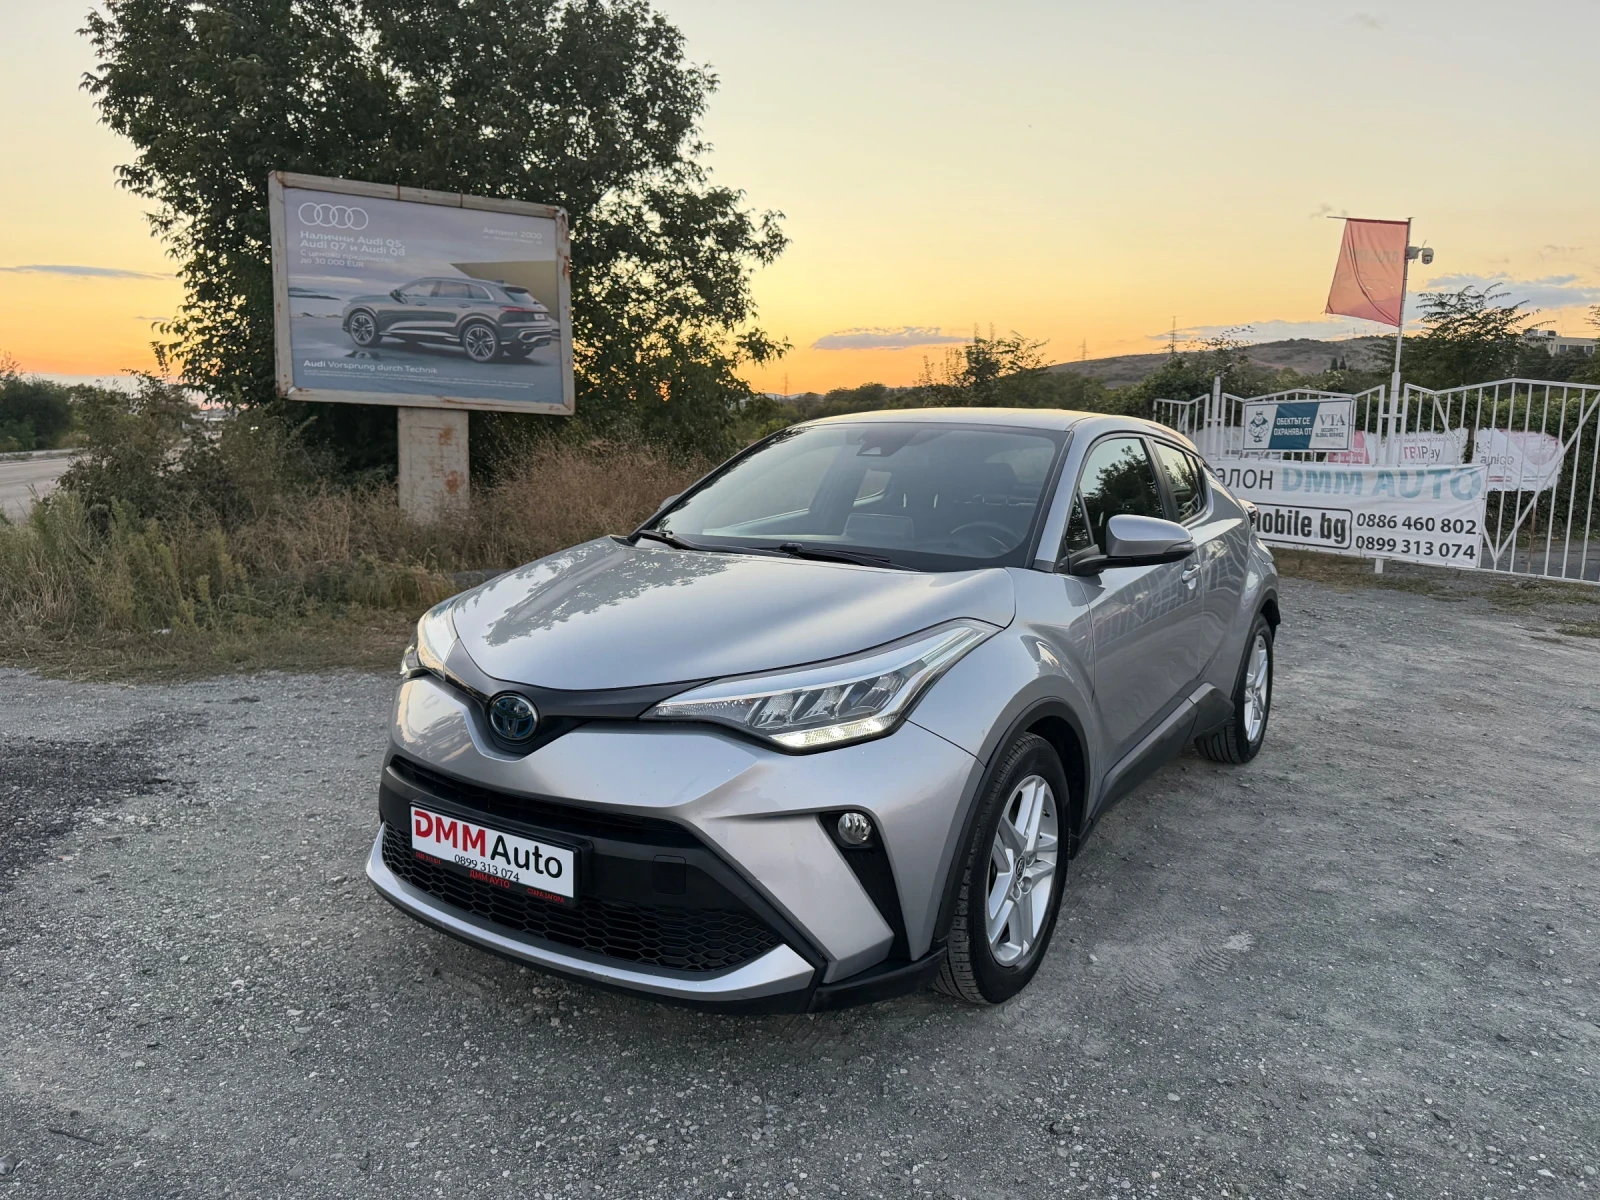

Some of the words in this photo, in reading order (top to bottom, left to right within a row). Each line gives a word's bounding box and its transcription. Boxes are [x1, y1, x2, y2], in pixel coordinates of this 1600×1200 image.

[300, 230, 354, 243] Налични
[358, 236, 383, 246] Audi
[386, 239, 406, 249] Q5,
[520, 232, 542, 240] 2000
[300, 240, 327, 249] Audi
[330, 241, 346, 251] Q7
[360, 245, 386, 254] Audi
[390, 247, 406, 257] Q8
[327, 258, 345, 266] 000
[346, 260, 364, 268] EUR
[304, 360, 326, 368] Audi
[328, 361, 376, 372] Vorsprung
[378, 364, 402, 372] durch
[405, 365, 438, 374] Technik
[1276, 418, 1302, 426] ОБЕКТЪТ
[1302, 416, 1310, 425] СЕ
[1319, 414, 1346, 426] VTA
[1274, 428, 1304, 436] ОХРАНЯВА
[1304, 427, 1312, 436] ОТ
[1214, 467, 1274, 490] алон
[1282, 468, 1364, 496] DMM
[1371, 467, 1482, 500] AUTO
[1356, 513, 1398, 529] 0886
[1402, 516, 1436, 532] 460
[1440, 518, 1477, 536] 802
[1356, 535, 1397, 552] 0899
[1400, 539, 1434, 556] 313
[1438, 542, 1476, 560] 074
[414, 810, 486, 858] DMM
[490, 834, 562, 878] Auto
[454, 854, 478, 868] 0899
[480, 862, 498, 875] 313
[500, 868, 520, 882] 074
[470, 870, 488, 882] ДММ
[490, 876, 510, 888] АУТО
[527, 888, 544, 898] СТАРА
[544, 893, 565, 904] ЗАГОРА
